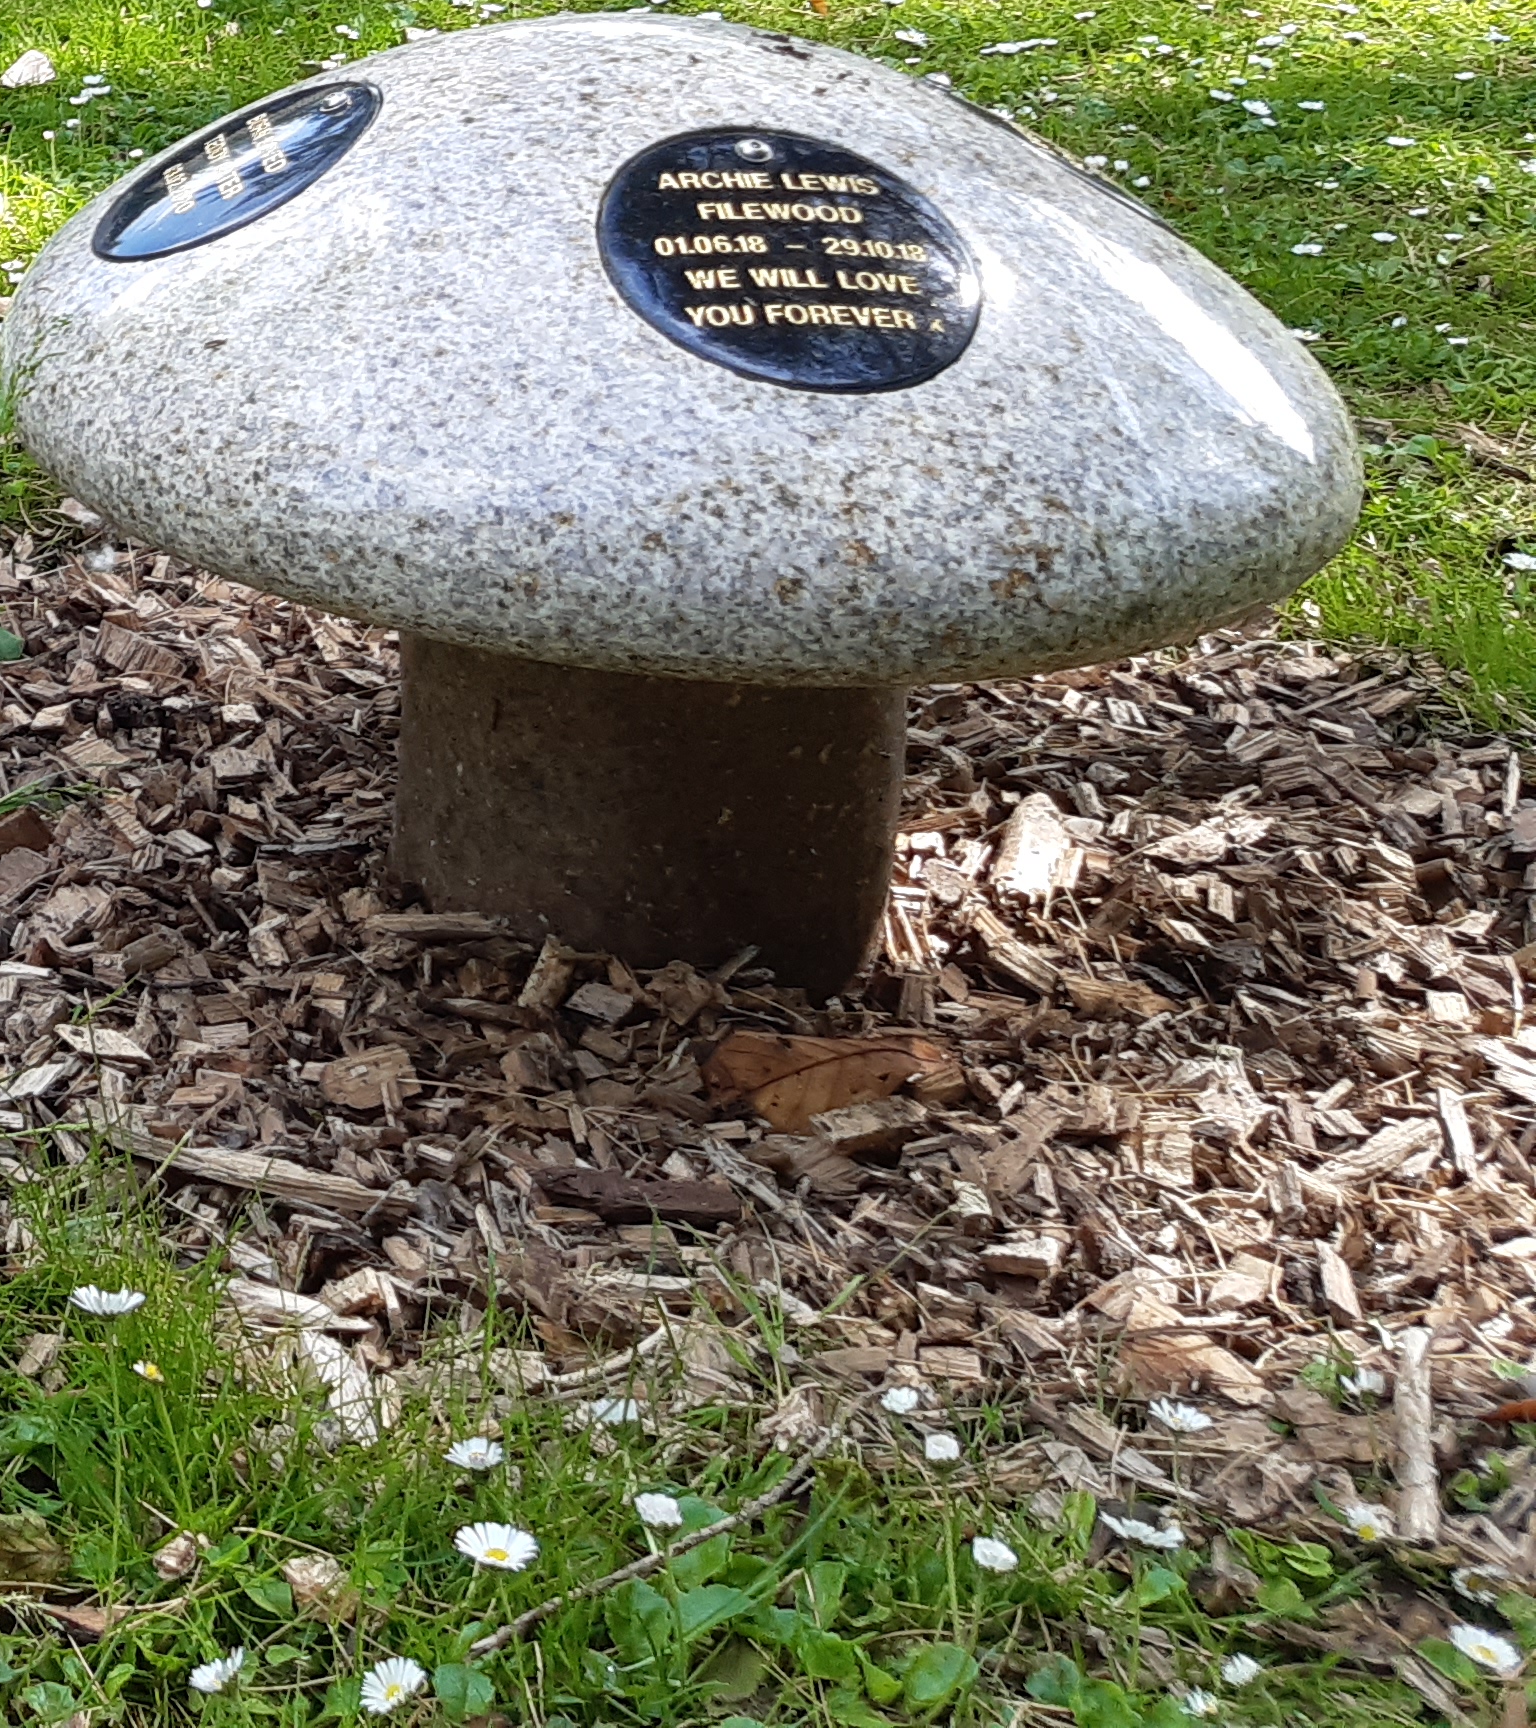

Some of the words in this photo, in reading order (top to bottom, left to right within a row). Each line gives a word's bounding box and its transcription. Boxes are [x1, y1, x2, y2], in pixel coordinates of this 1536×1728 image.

[658, 172, 774, 191] ARCHIE
[780, 172, 880, 196] LEWIS
[698, 203, 864, 224] FILEWOOD
[655, 235, 768, 256] 01.06.18
[822, 236, 928, 263] 29.10.18
[685, 269, 741, 290] WE
[748, 268, 828, 289] WILL
[837, 270, 922, 295] LOVE
[685, 305, 755, 328] YOU
[765, 304, 917, 331] FOREVER
